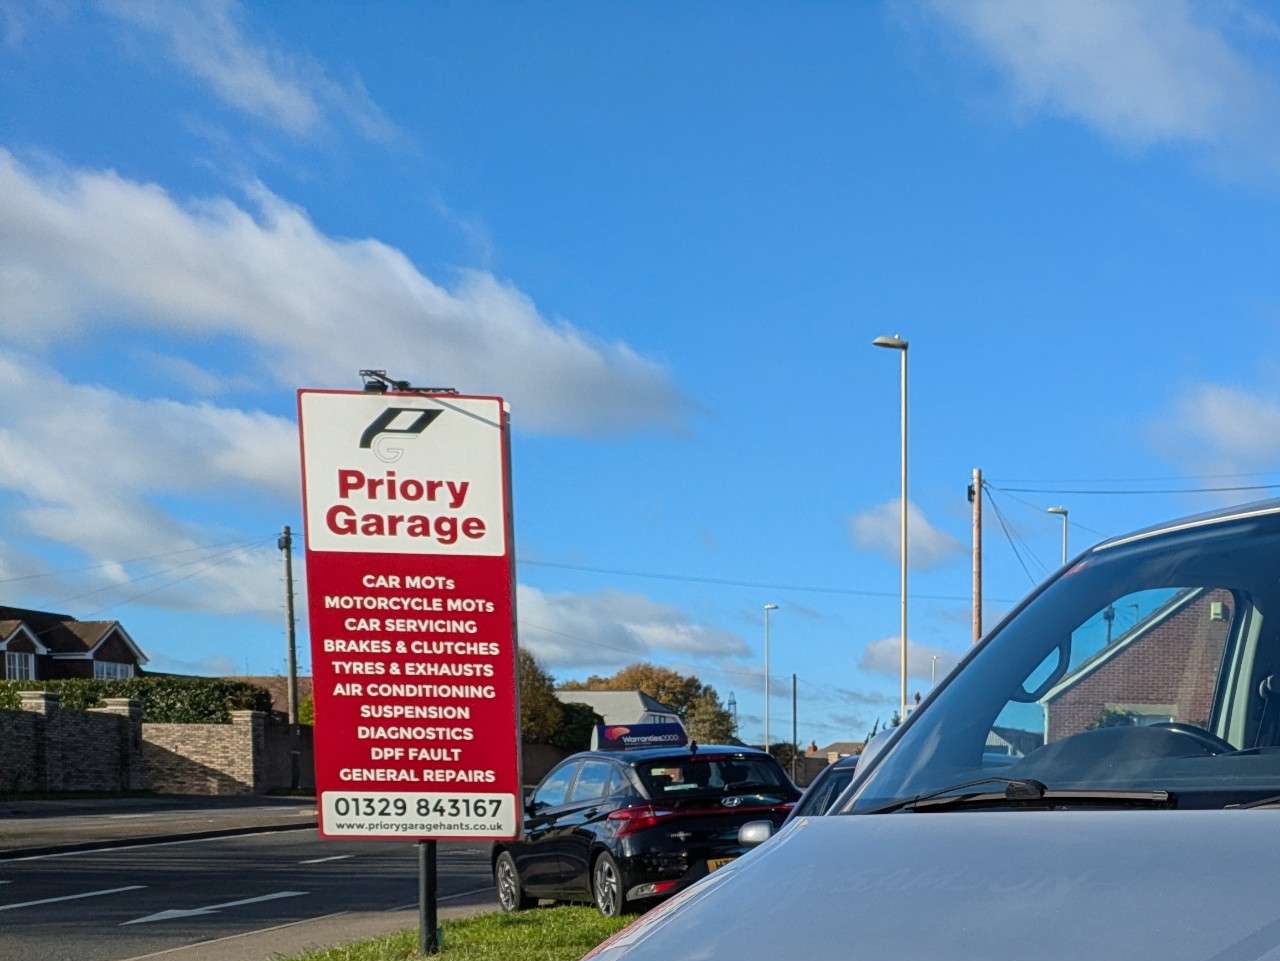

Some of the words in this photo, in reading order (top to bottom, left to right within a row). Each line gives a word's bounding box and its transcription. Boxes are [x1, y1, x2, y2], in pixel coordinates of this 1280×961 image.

[338, 469, 469, 509] Priory
[326, 504, 486, 545] Garage
[362, 574, 400, 588] CAR
[405, 576, 455, 590] MOTs
[324, 596, 443, 611] MOTORCYCLE
[447, 599, 494, 613] MOTs
[344, 618, 381, 632] CAR
[384, 619, 477, 634] SERVICING
[324, 640, 391, 653] BRAKES
[396, 641, 407, 653] &
[410, 641, 500, 655] CLUTCHES
[332, 661, 385, 675] TYRES
[389, 662, 400, 675] &
[405, 663, 494, 677] EXHAUSTS
[333, 683, 363, 696] AIR
[366, 684, 496, 699] CONDITIONING
[360, 705, 470, 719] SUSPENSION
[357, 726, 474, 740] DIAGNOSTICS
[371, 747, 404, 760] DPF
[408, 748, 462, 761] FAULT
[339, 768, 419, 782] GENERAL
[423, 770, 495, 783] REPAIRS
[334, 797, 407, 817] 01329
[416, 798, 502, 817] 843167
[335, 821, 503, 833] www.priorygaragehants.co.uk
